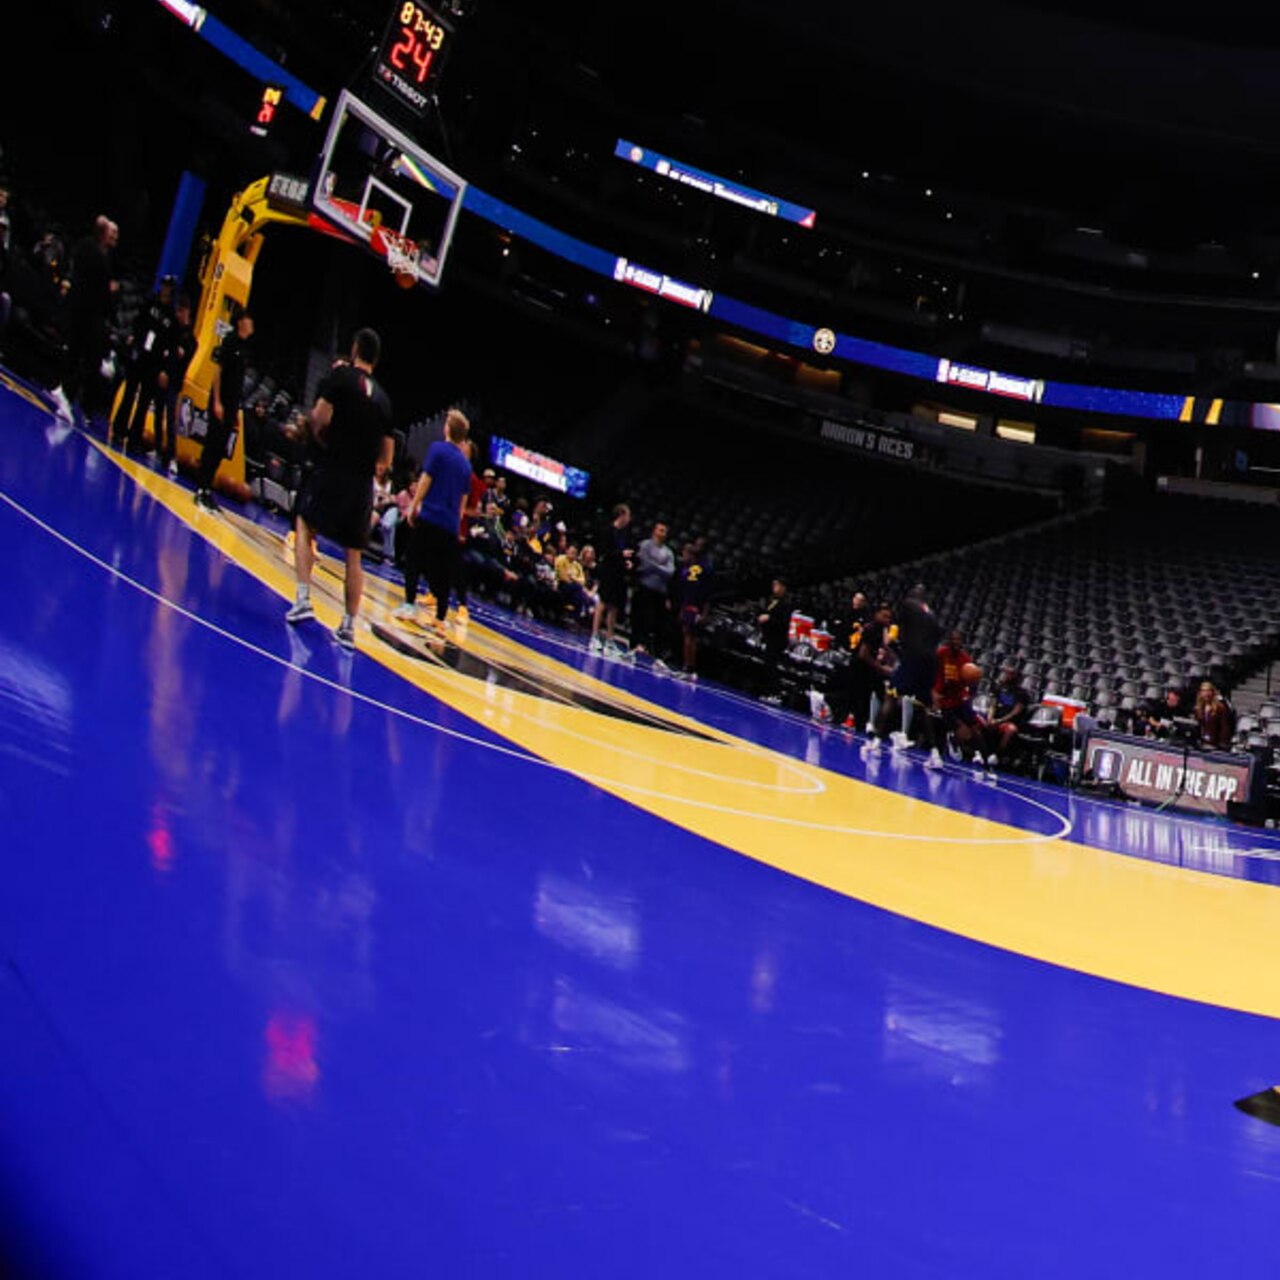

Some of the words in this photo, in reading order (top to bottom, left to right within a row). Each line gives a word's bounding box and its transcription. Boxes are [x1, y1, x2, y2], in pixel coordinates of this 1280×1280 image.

[400, 1, 444, 50] 87:43
[390, 26, 433, 82] 24
[391, 73, 428, 108] TISSOT
[1126, 759, 1152, 787] ALL
[1155, 763, 1172, 790] IN
[1205, 773, 1238, 802] APP.
